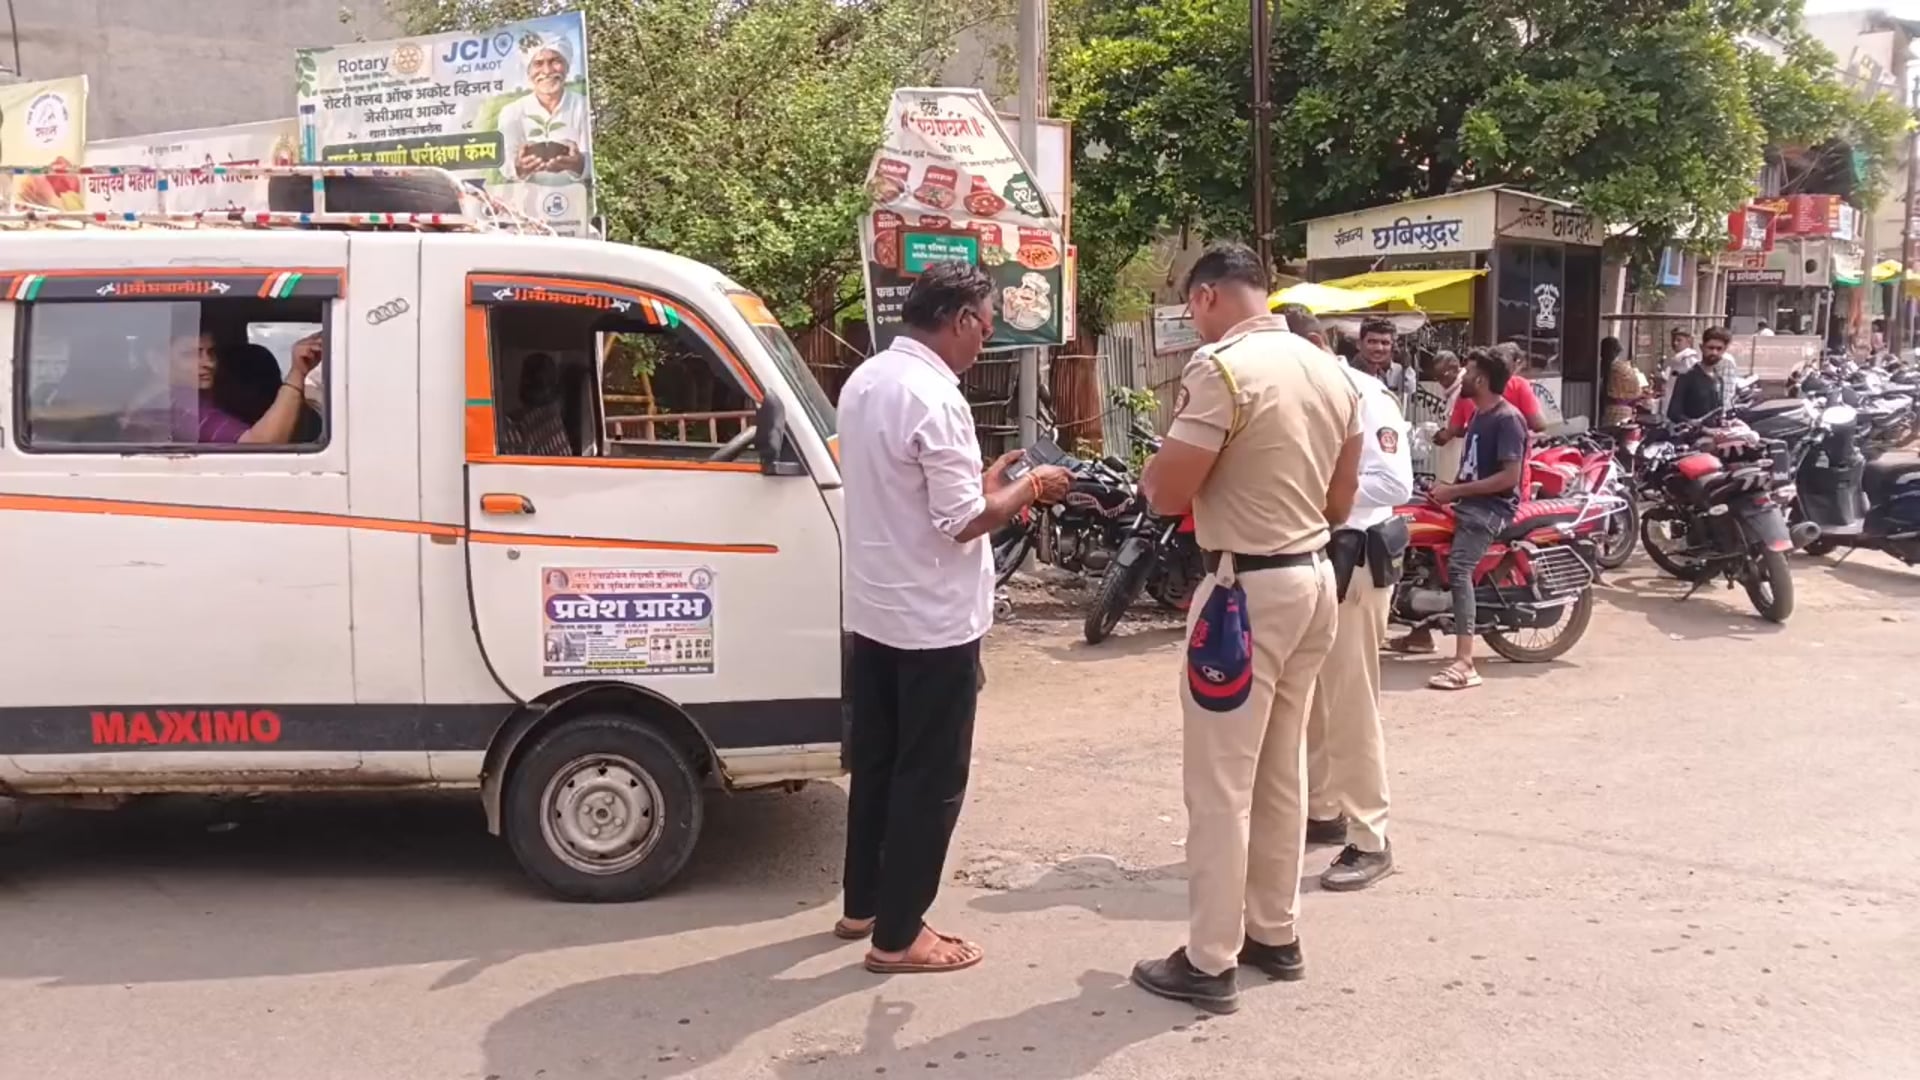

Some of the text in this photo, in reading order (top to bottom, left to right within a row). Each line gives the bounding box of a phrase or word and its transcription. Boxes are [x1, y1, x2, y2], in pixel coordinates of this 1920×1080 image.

[442, 38, 488, 63] JCI
[338, 56, 389, 74] Rotary
[455, 60, 503, 75] JCI AKOT
[323, 92, 352, 110] रोटरी
[354, 92, 383, 107] क्लब
[386, 87, 413, 103] ऑफ
[416, 82, 451, 99] अकोट
[453, 80, 491, 97] व्हिजन
[493, 79, 504, 92] व
[364, 101, 456, 123] जेसीआय आकोट
[410, 142, 460, 164] परीक्षण
[1371, 214, 1463, 251] छबिसुंदर
[552, 594, 705, 620] प्रवेश प्रारंभ
[90, 710, 282, 745] MAXXIMO
